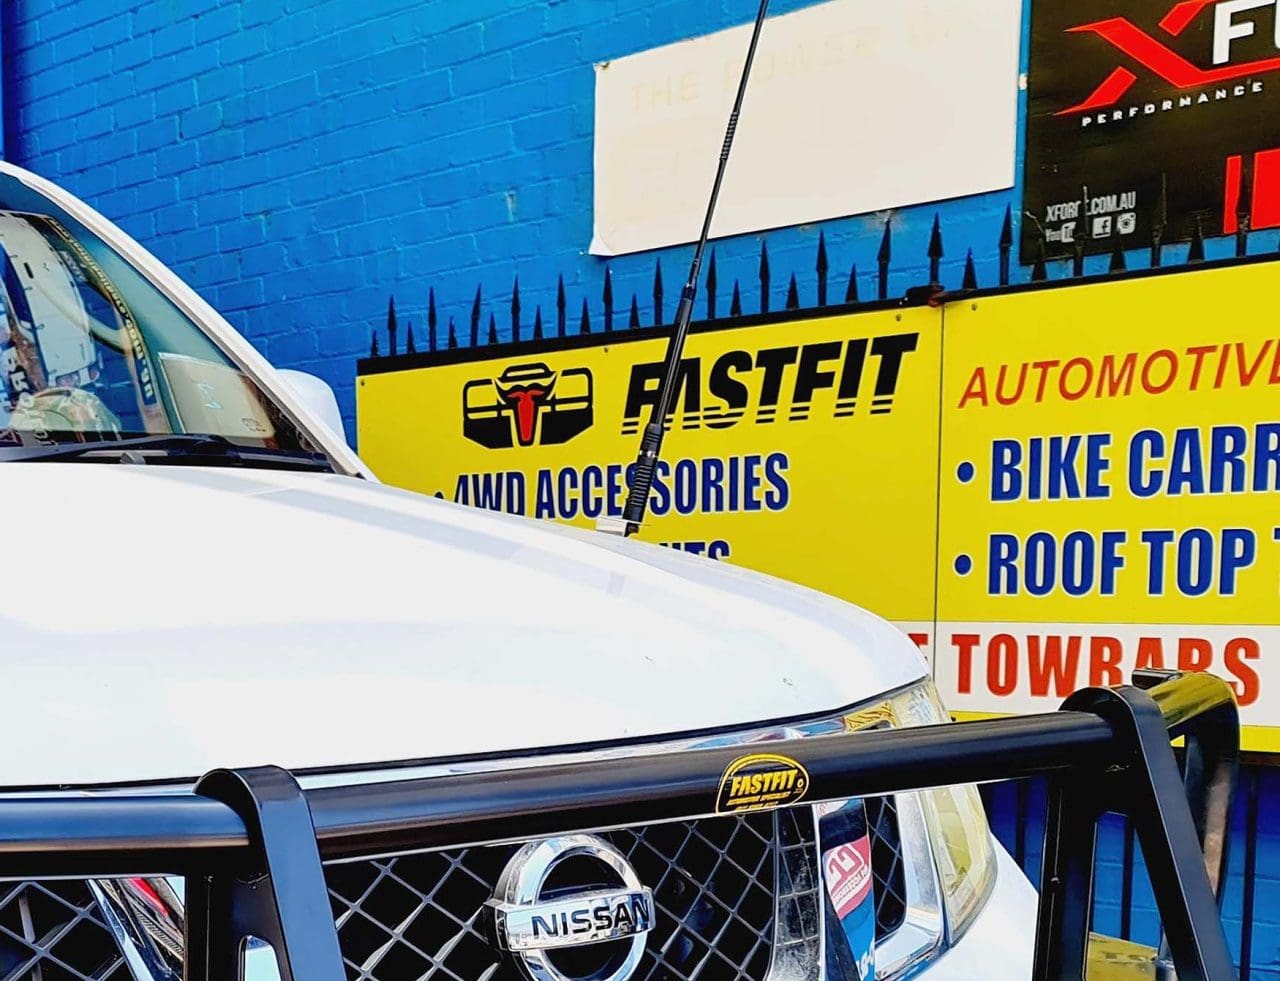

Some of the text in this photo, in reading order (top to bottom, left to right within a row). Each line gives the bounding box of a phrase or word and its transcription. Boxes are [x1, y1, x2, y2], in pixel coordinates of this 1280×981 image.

[1053, 0, 1280, 116] XF
[1082, 82, 1263, 127] PERFORMANCE
[1046, 191, 1136, 222] XFOR.COM.AU
[621, 332, 919, 435] FASTFIT
[990, 423, 1280, 501] BIKE CARR
[988, 531, 1127, 596] ROOF
[1141, 528, 1256, 596] TOP
[729, 769, 798, 797] FASTFIT
[531, 897, 650, 937] NISSAN
